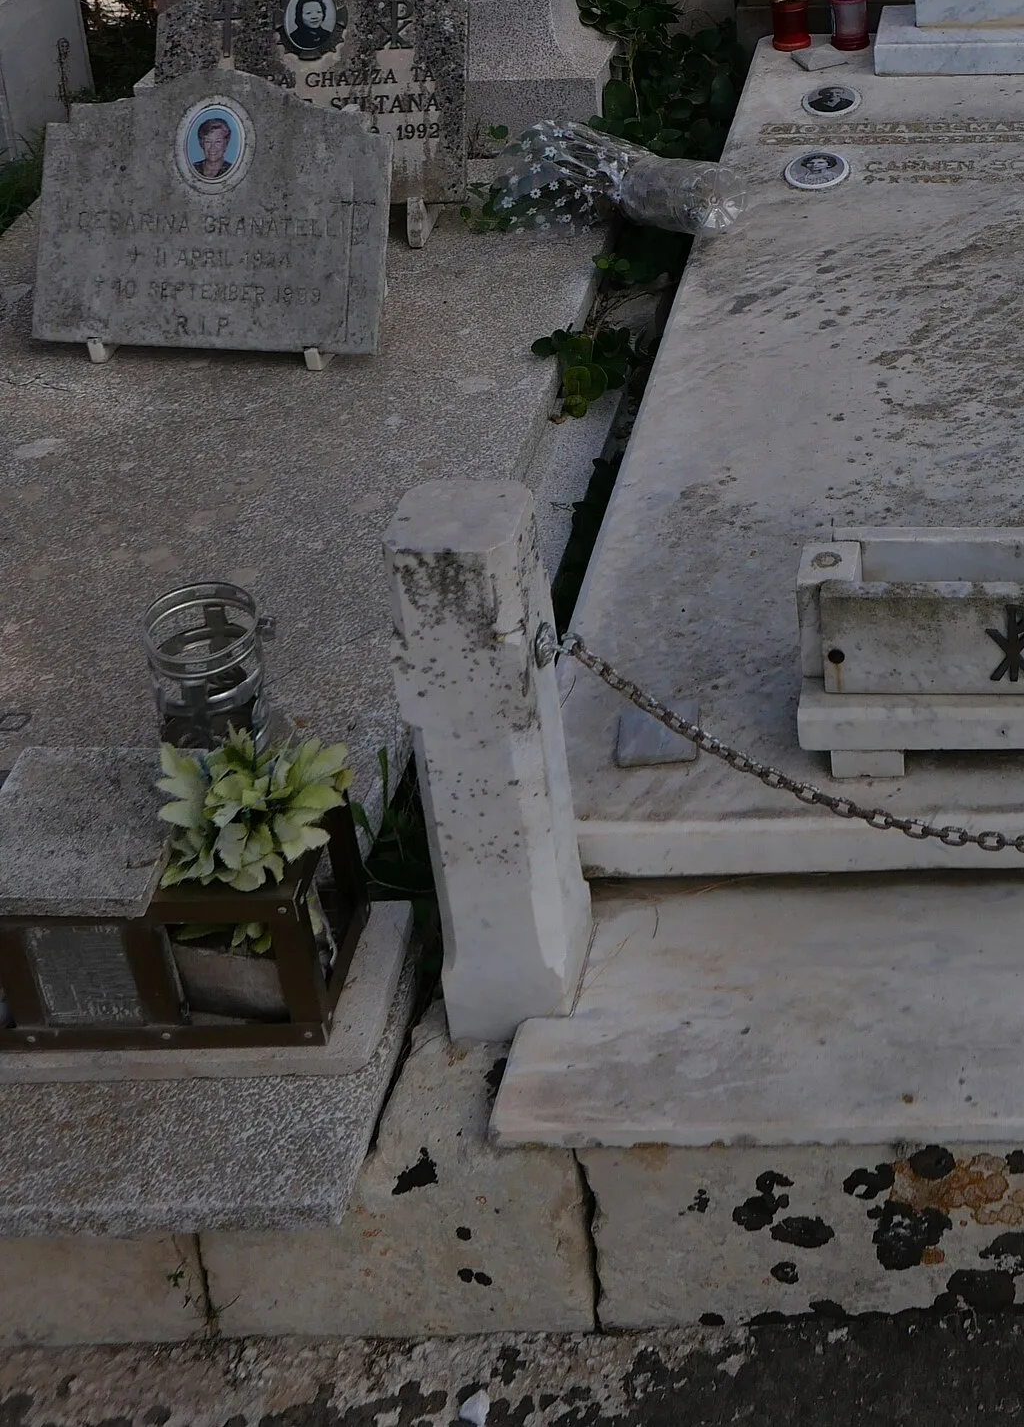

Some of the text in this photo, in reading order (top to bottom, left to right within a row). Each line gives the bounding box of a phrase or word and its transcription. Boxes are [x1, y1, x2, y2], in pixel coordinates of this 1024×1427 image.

[305, 68, 398, 88] GHAZIZA
[396, 123, 440, 141] 1992
[177, 249, 233, 269] APRIL
[149, 280, 267, 305] SEPTEMBER
